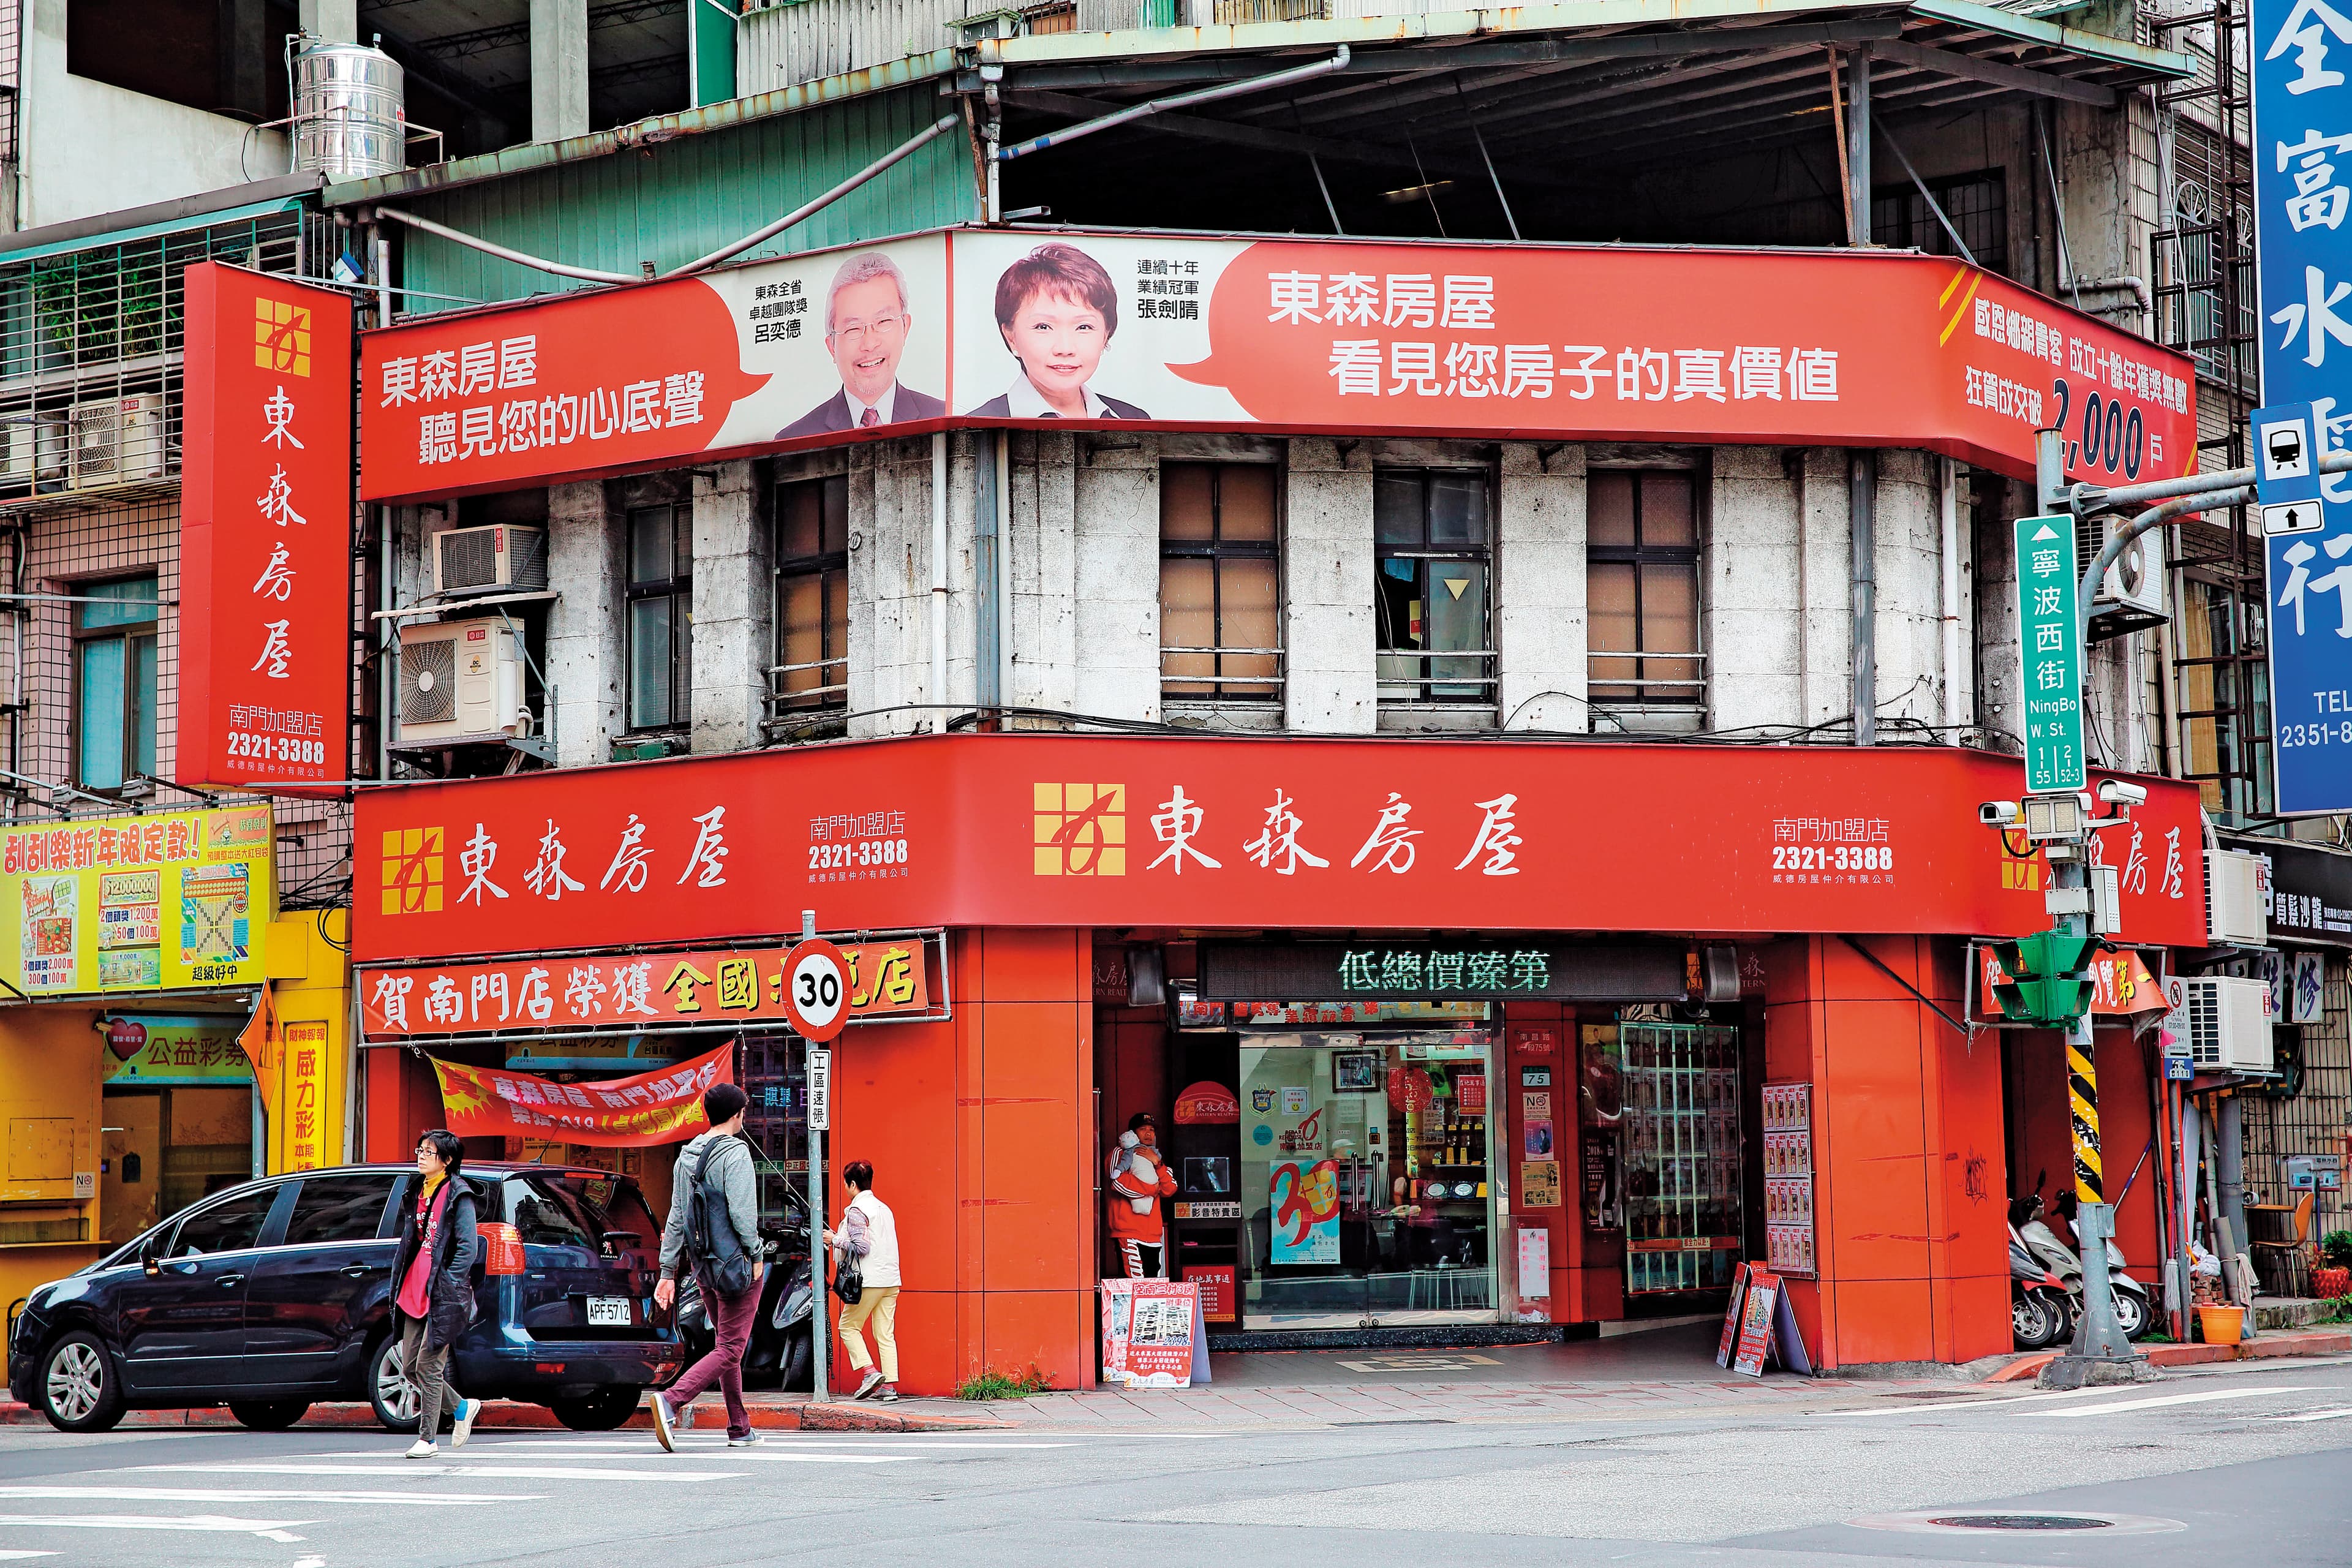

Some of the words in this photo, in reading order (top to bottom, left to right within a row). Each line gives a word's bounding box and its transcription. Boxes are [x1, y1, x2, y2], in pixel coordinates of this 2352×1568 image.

[1137, 259, 1199, 276] 連續十年
[755, 279, 802, 301] 東森全省
[1137, 279, 1199, 295] 業績冠軍
[1267, 270, 1496, 330] 東森房屋
[749, 298, 807, 321] 卓越團隊獎
[1137, 299, 1199, 320] 張劍晴
[755, 319, 801, 344] 呂奕德
[1975, 297, 2062, 367] 感恩鄉親貴客
[2069, 337, 2188, 416] 成立十餘年獲獎無數
[380, 334, 537, 408] 東森房屋
[1328, 339, 1839, 404] 看見您房子的真價值
[419, 370, 704, 465] 聽見您的心底聲
[2052, 377, 2143, 481] 2,000
[2150, 432, 2163, 468] 戶
[251, 385, 307, 679] 東森房屋
[2032, 549, 2066, 691] 寧波西街
[229, 703, 323, 737] 南門加盟店
[2030, 697, 2076, 717] NingBo
[2030, 724, 2045, 738] W.
[2049, 723, 2067, 737] St.
[227, 731, 325, 765] 2321-3388
[2038, 747, 2045, 760] 1
[2064, 745, 2072, 759] 2
[227, 759, 325, 778] 威德房屋仲介有限公司
[2036, 771, 2051, 785] 55
[2060, 768, 2080, 783] 52-3
[809, 809, 906, 842] 南門加盟店
[1147, 785, 1523, 876] 東森房屋
[1773, 816, 1890, 843] 南門加盟店
[4, 818, 202, 875] 刮刮樂新年限定款!
[456, 805, 729, 907] 東森房屋
[809, 839, 908, 869] 2321-3388
[1773, 846, 1893, 870] 2321-3388
[809, 867, 908, 883] 威德房屋仲介有限公司
[1773, 874, 1893, 884] 威德房屋仲介有限公司
[100, 907, 158, 922] 2個頭獎1,200萬
[2276, 892, 2323, 930] 質髮沙龍
[117, 925, 157, 939] 50個100萬
[24, 957, 74, 971] 3個頭獎2,000萬
[192, 965, 238, 981] 超級好中
[28, 973, 67, 985] 300個100萬
[799, 973, 839, 1008] 30
[371, 961, 659, 1030] 賀南門店榮獲
[289, 1028, 325, 1041] 財神報報
[148, 1036, 246, 1066] 公益彩券
[492, 1077, 594, 1109] 東森房屋
[596, 1061, 717, 1108] 南門加盟店
[813, 1055, 825, 1123] 工區速限
[1529, 1075, 1544, 1084] 75
[296, 1049, 316, 1139] 威力彩
[295, 1144, 314, 1158] 本期
